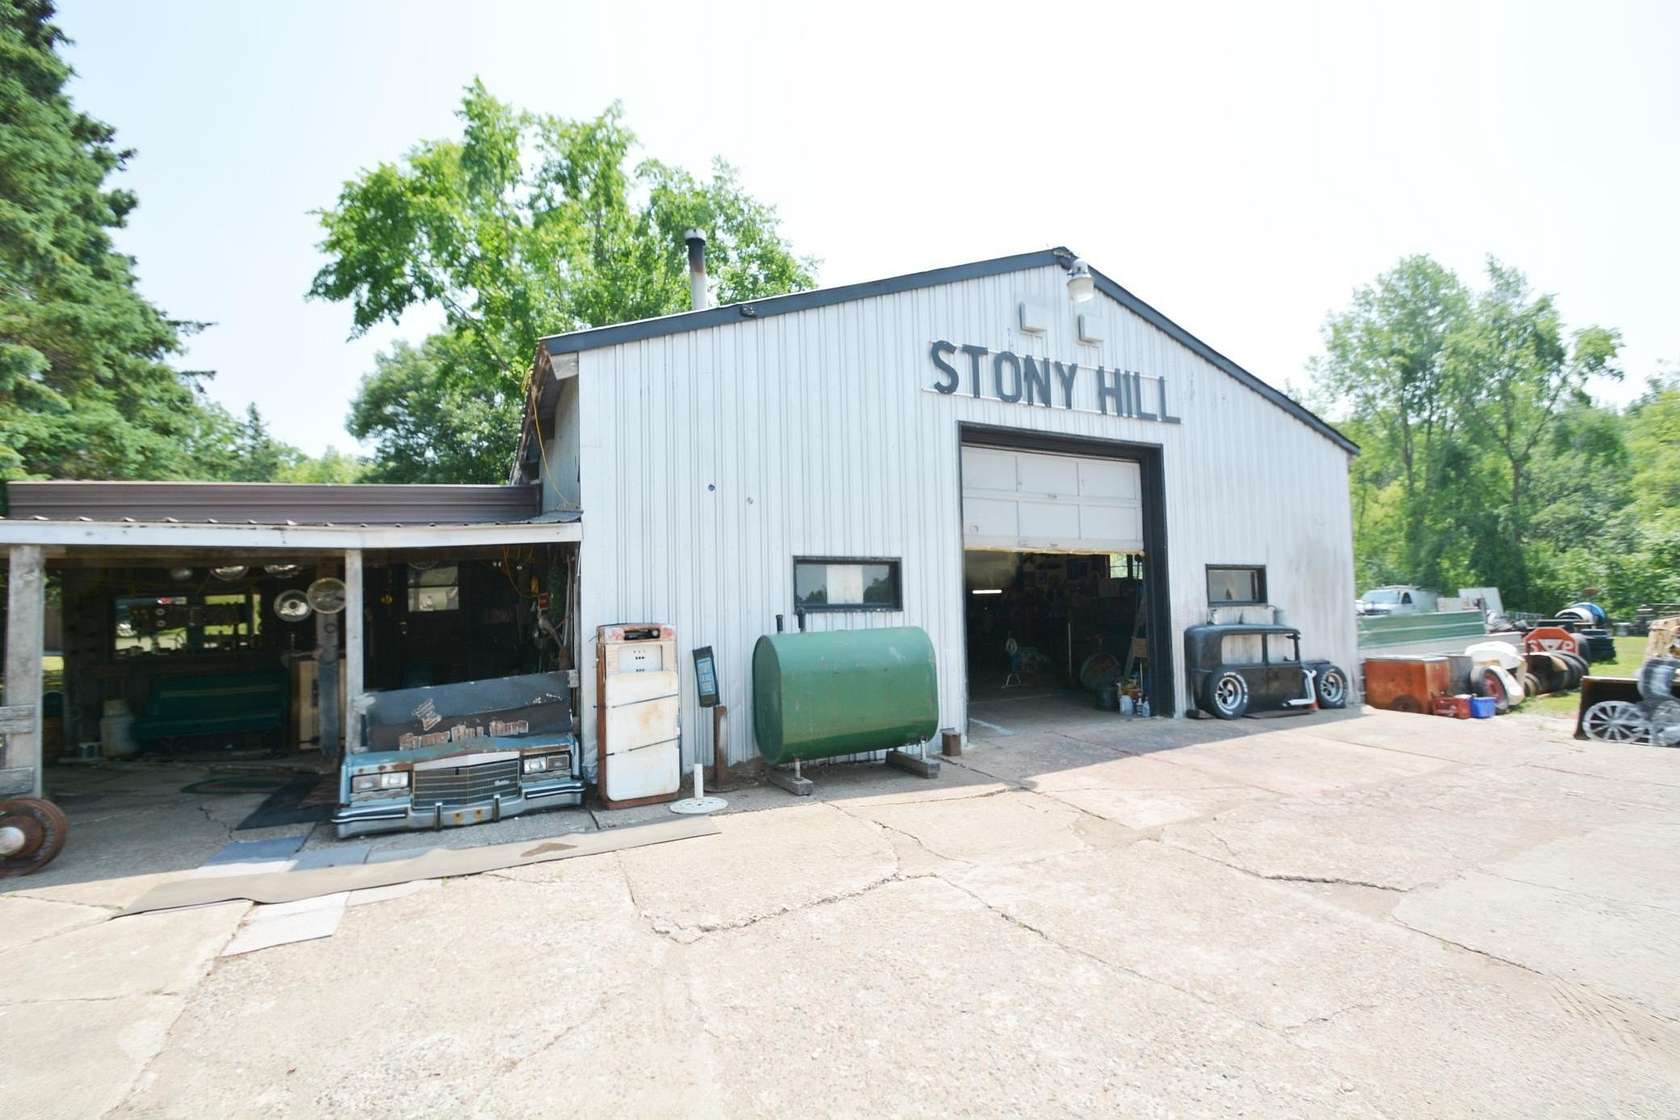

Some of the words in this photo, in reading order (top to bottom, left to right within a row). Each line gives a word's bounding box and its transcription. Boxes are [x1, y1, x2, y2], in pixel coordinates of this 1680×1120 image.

[931, 340, 1078, 409] STONY
[1097, 366, 1181, 424] HILL
[1527, 640, 1575, 652] SP
